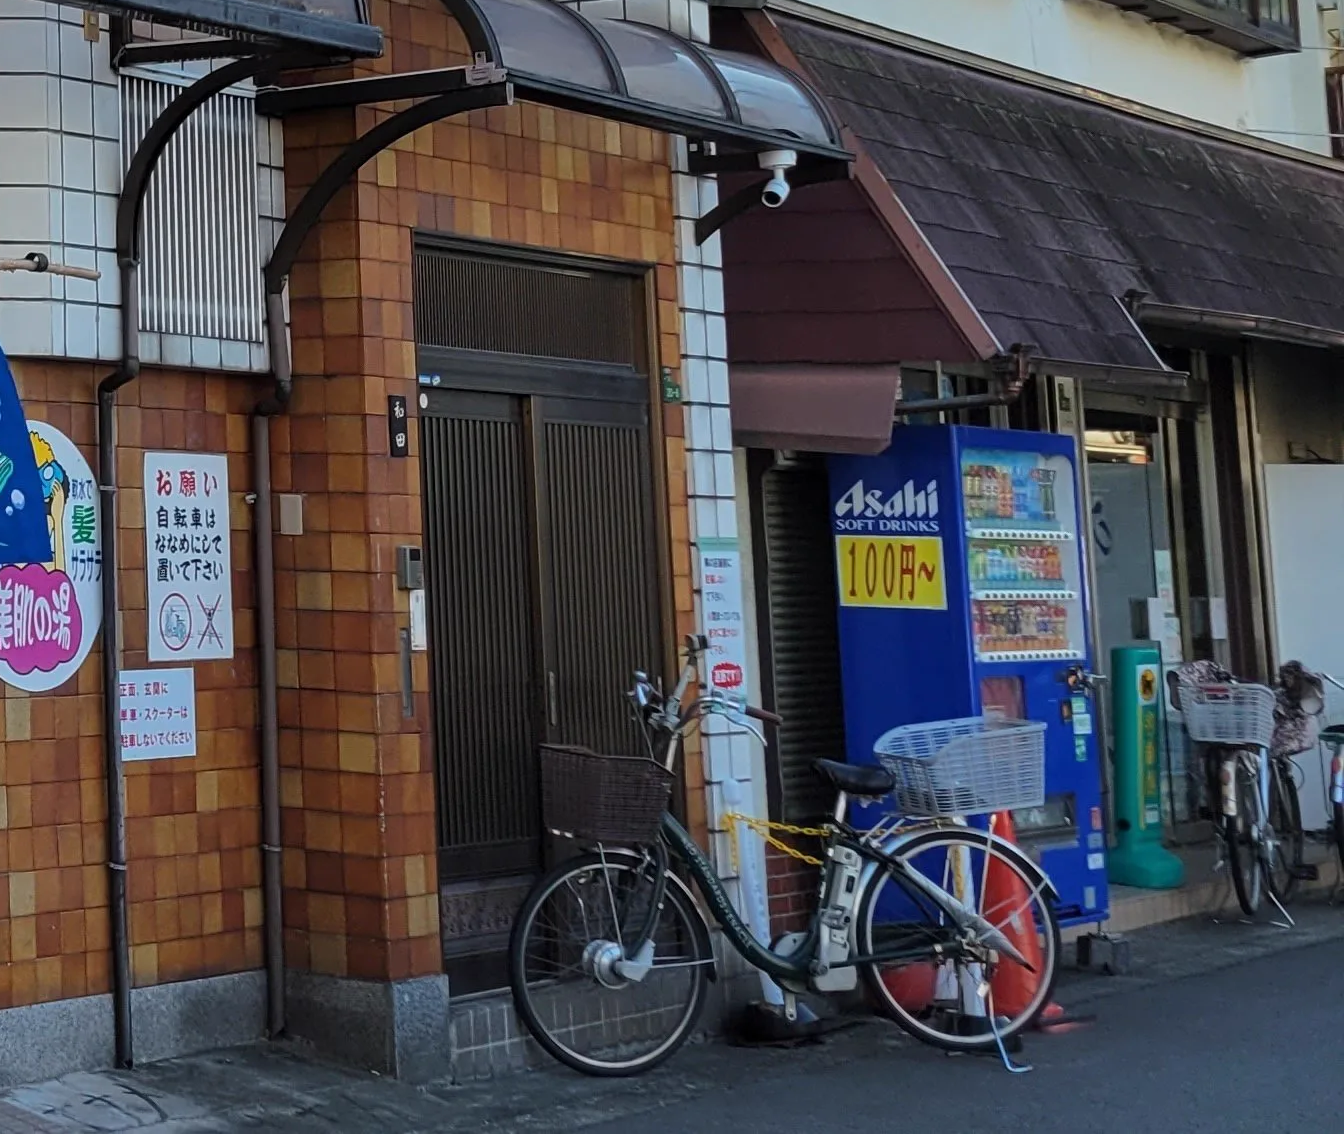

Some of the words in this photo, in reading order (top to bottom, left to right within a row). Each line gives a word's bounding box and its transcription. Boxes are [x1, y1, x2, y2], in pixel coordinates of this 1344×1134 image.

[156, 469, 218, 497] お願い
[835, 479, 939, 518] Asahi
[71, 504, 96, 545] 髪
[156, 506, 216, 529] 自転車は
[836, 519, 875, 531] SOFT
[879, 519, 940, 532] DRINKS
[155, 534, 222, 555] ななめにして
[71, 548, 102, 583] サラサラ
[156, 558, 224, 583] 置いて下さい
